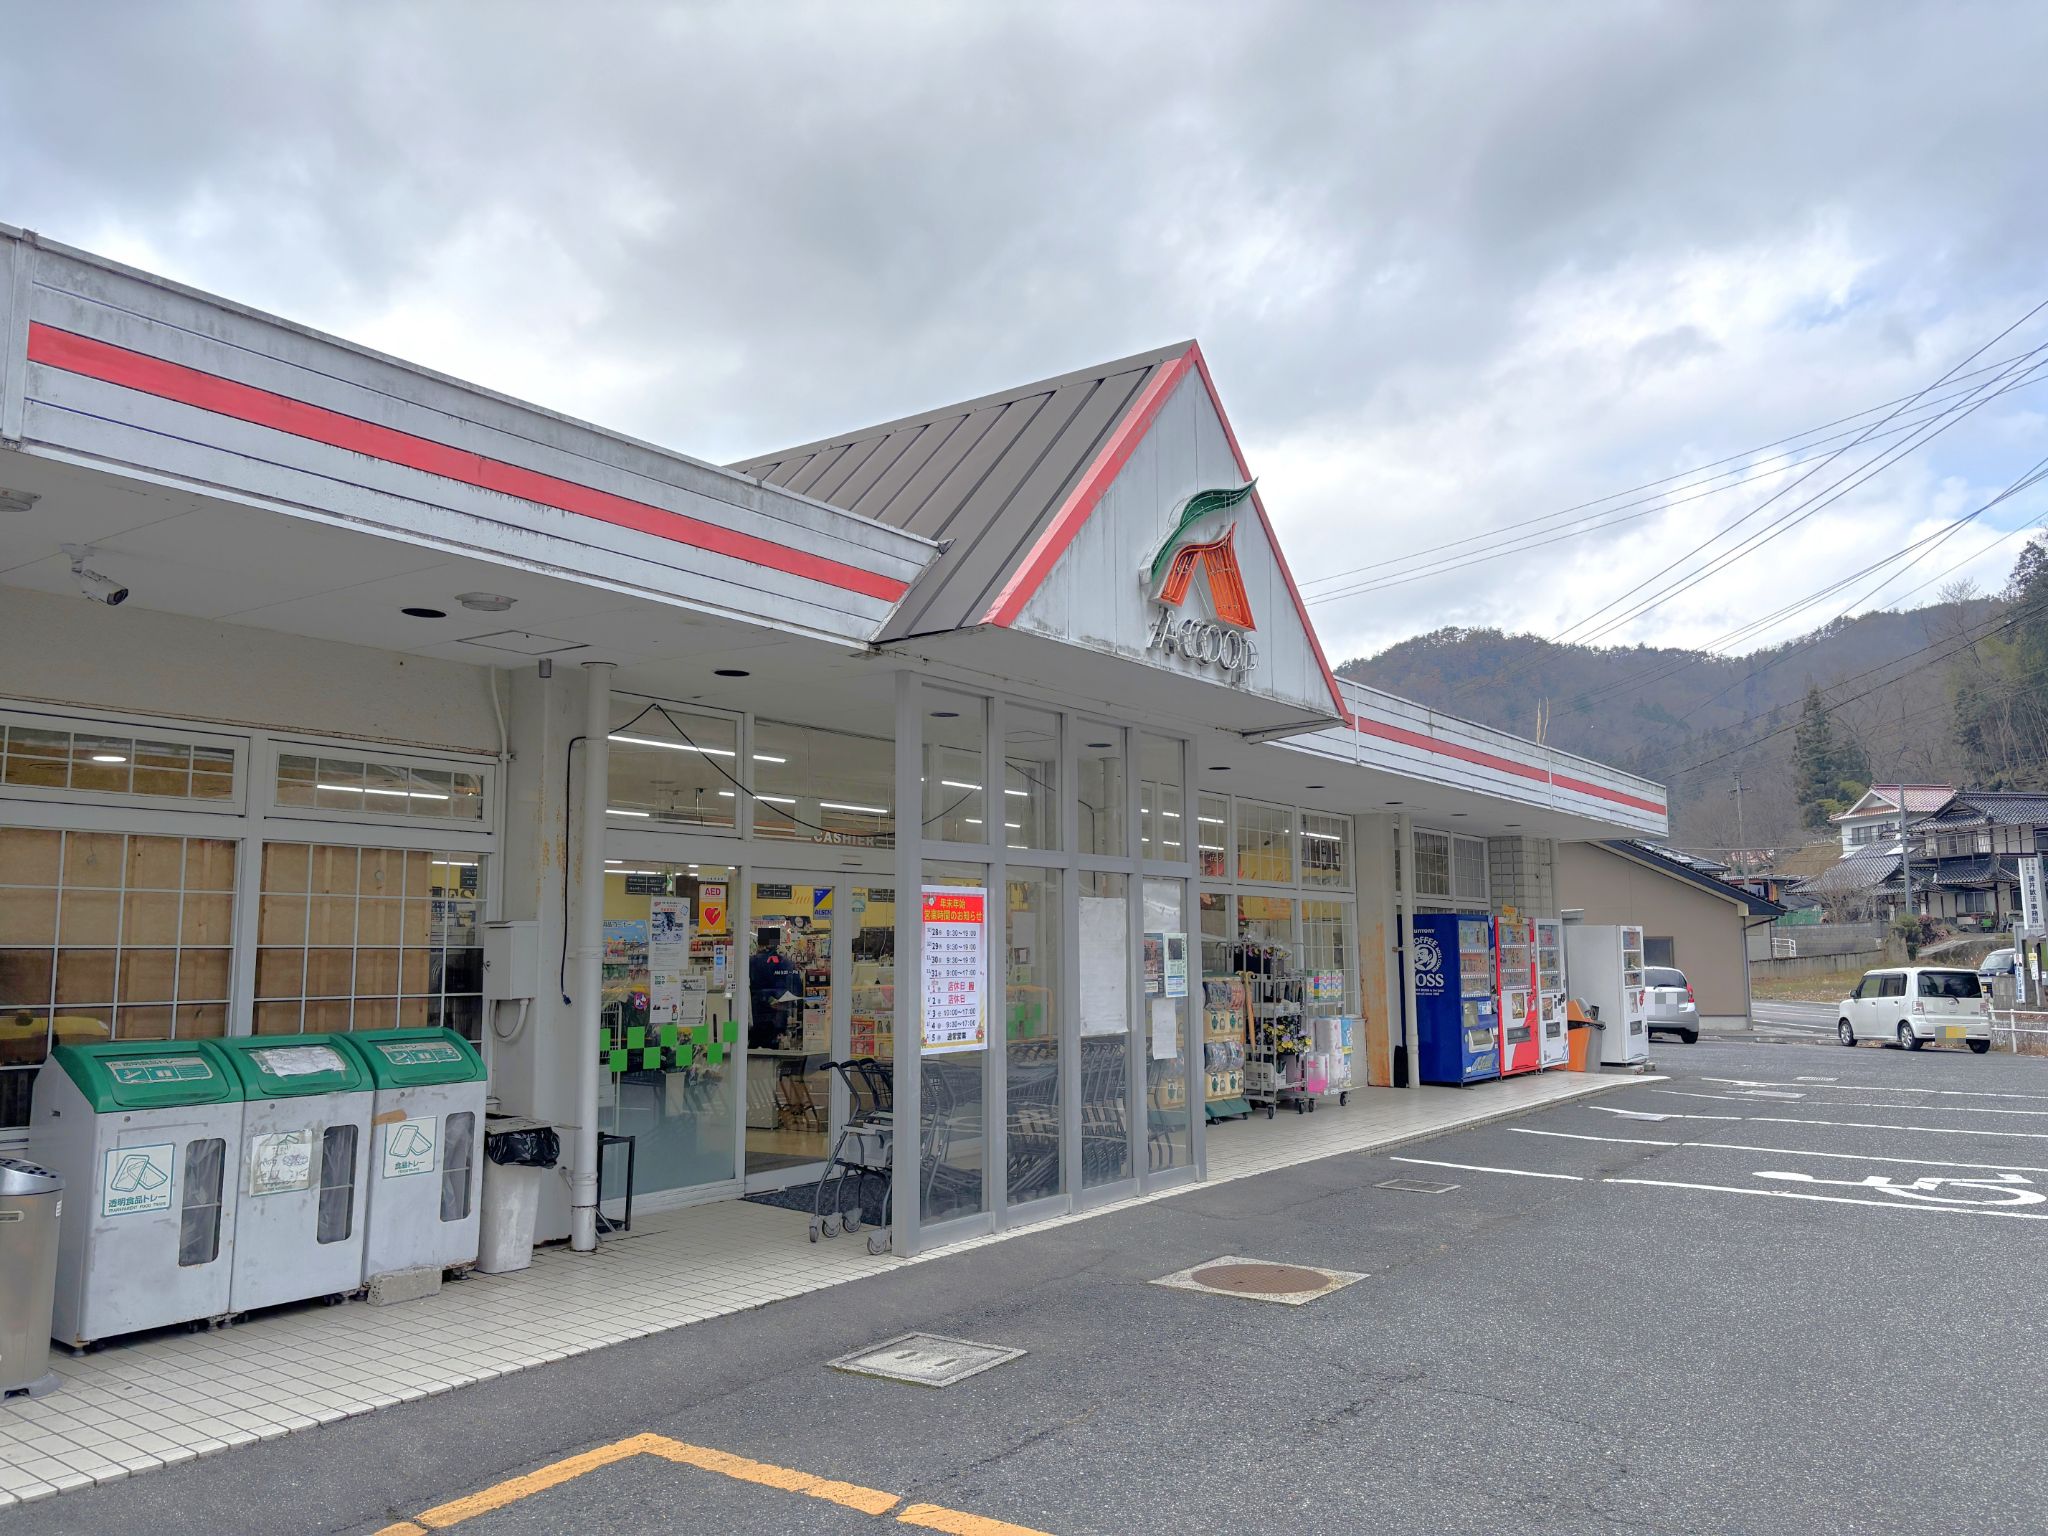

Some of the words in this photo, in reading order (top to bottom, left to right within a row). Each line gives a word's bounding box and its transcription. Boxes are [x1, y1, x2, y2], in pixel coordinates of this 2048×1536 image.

[705, 887, 721, 896] AED
[940, 898, 966, 909] 年末年始
[924, 909, 983, 921] 営業時間のお知らせ
[1413, 936, 1439, 948] OFFEE
[1414, 973, 1445, 987] OSS
[108, 1194, 167, 1208] 透明食品トレー
